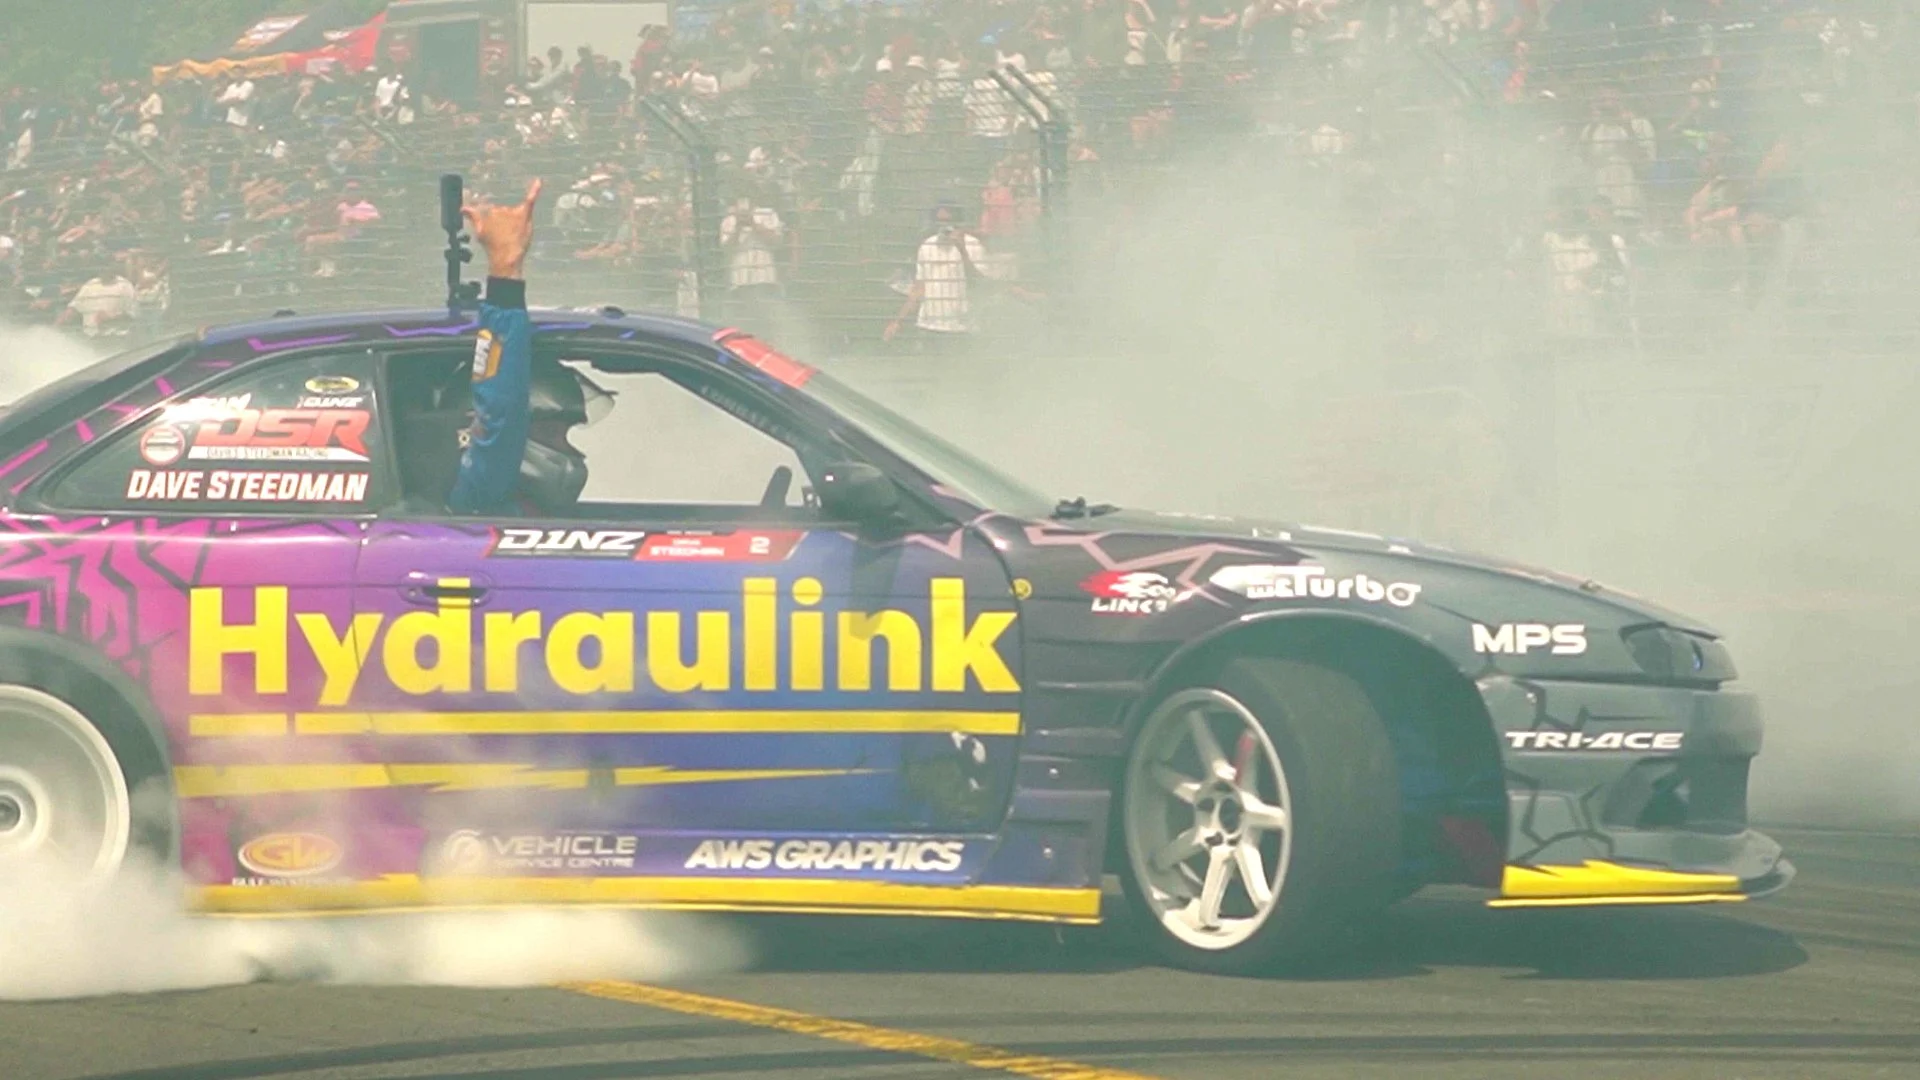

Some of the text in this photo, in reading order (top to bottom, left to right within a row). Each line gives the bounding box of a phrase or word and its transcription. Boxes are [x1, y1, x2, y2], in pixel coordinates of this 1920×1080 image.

[195, 409, 371, 454] DSR
[127, 470, 368, 501] DAVE STEEDMAN
[498, 529, 645, 549] D1NZ
[750, 536, 770, 554] 2
[189, 577, 1022, 707] Hydraulink
[1472, 623, 1588, 654] MPS
[1505, 731, 1684, 749] TRI-ACE
[491, 836, 638, 855] VEHICLE
[684, 840, 964, 871] AWS GRAPHICS
